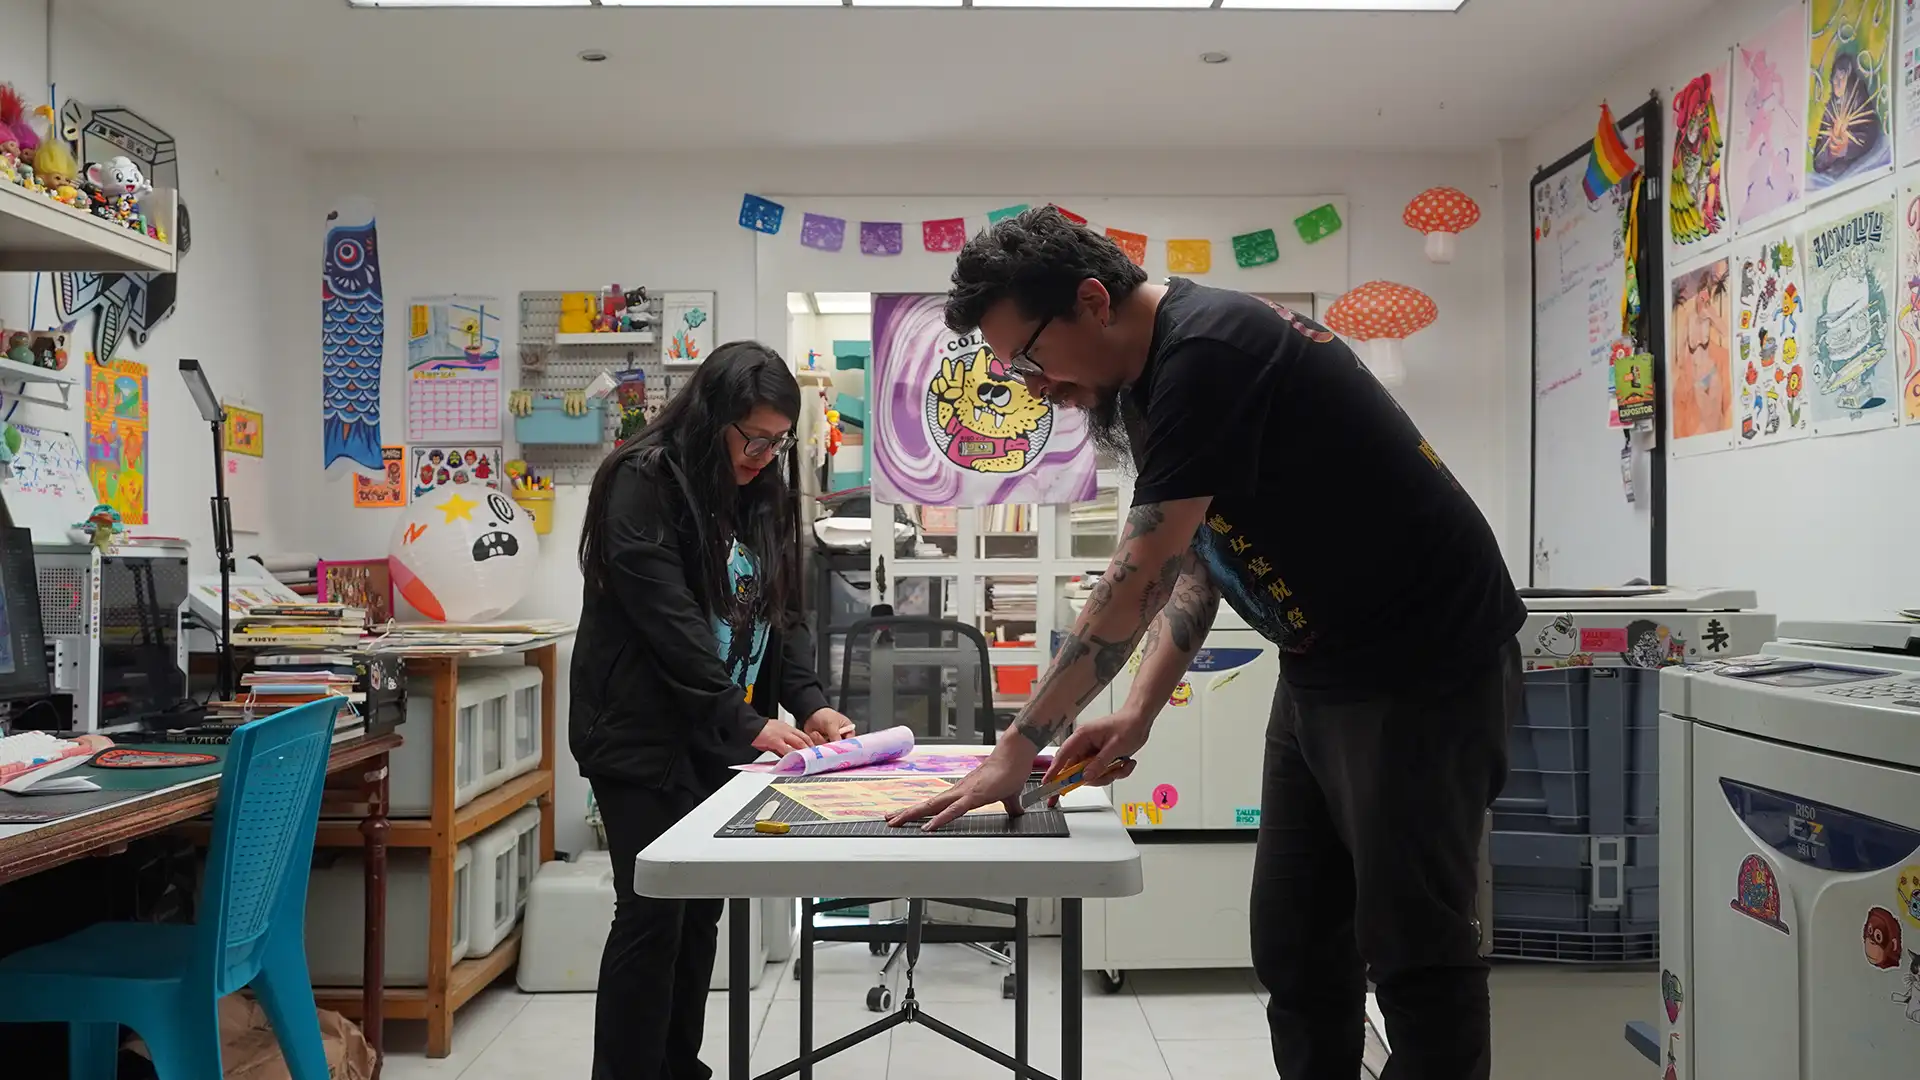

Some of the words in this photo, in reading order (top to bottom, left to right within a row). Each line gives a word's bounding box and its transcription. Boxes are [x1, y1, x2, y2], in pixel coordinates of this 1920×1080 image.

[1813, 210, 1884, 268] HONOLULU
[190, 736, 223, 745] AZTEC
[1795, 803, 1816, 820] RISO
[1789, 816, 1826, 847] EZ
